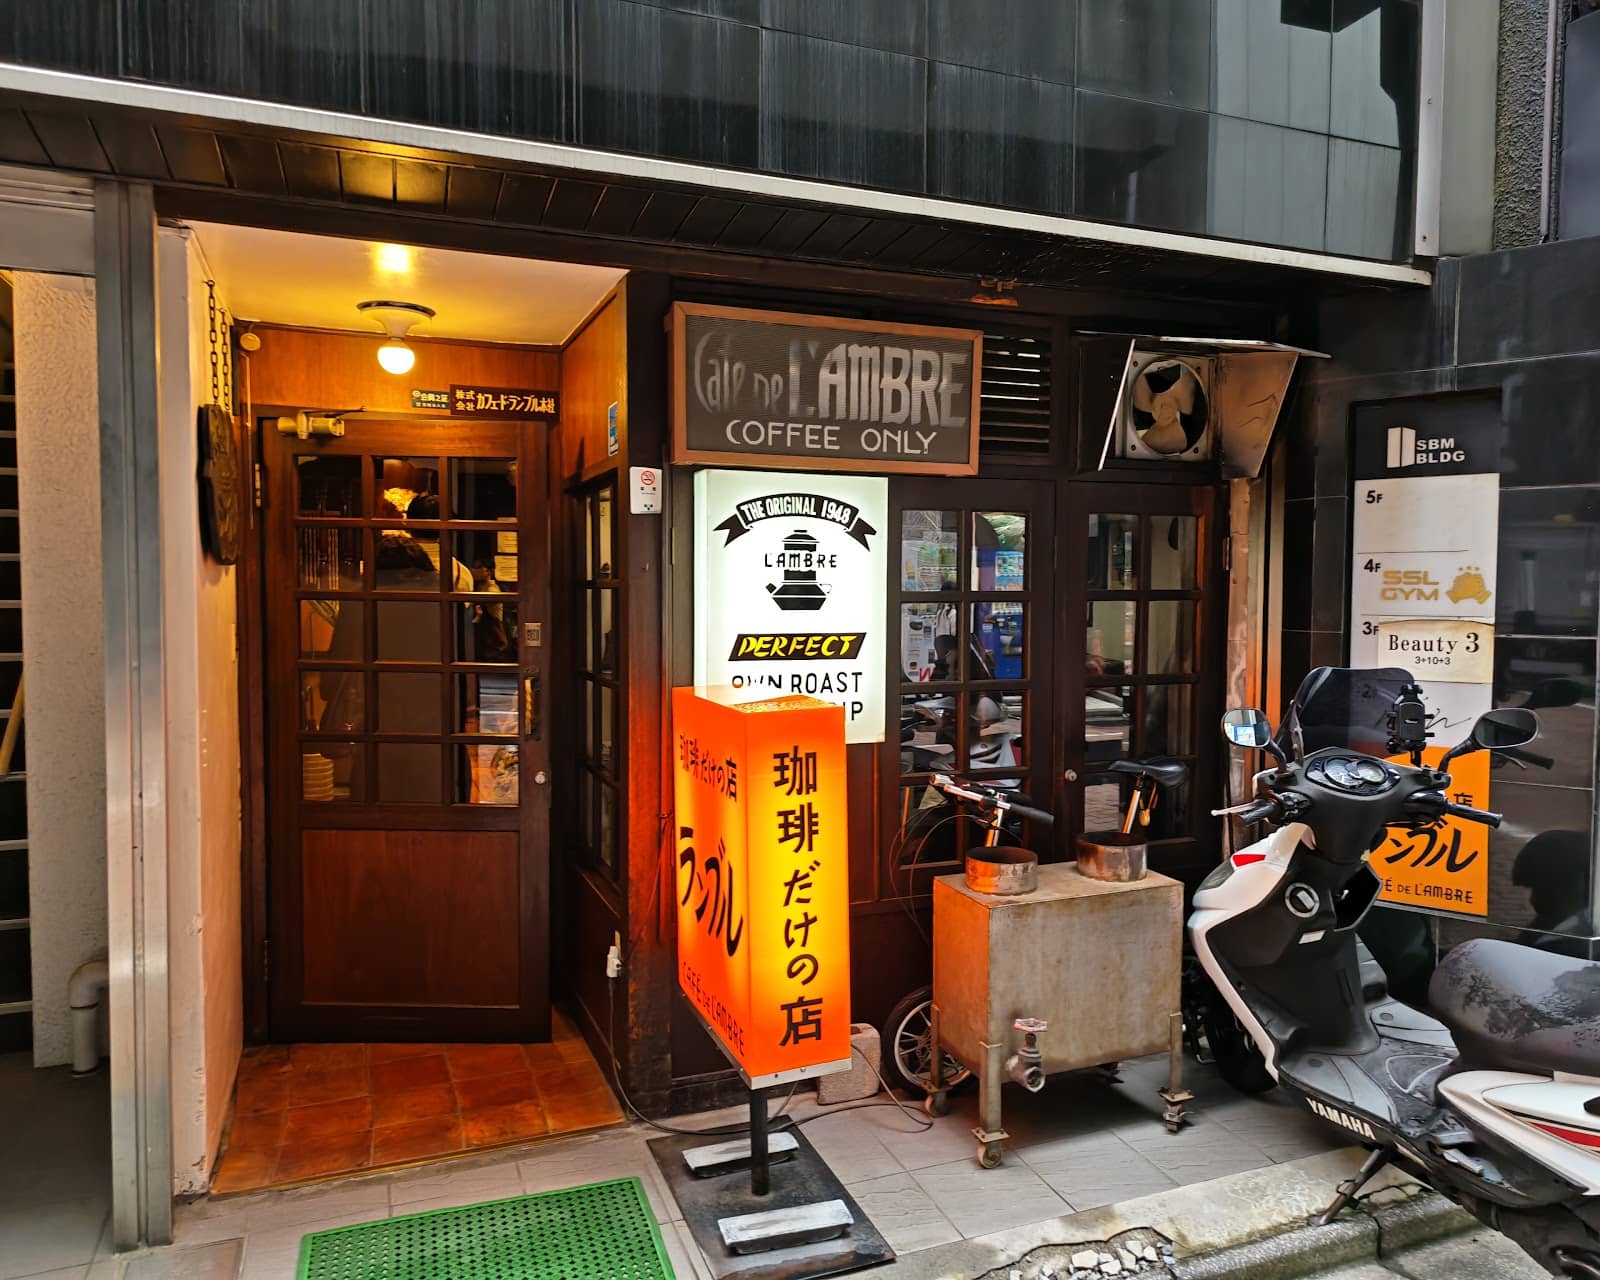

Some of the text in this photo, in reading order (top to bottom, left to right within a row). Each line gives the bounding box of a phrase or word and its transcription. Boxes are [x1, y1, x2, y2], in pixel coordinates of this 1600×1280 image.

[725, 419, 937, 454] COFFEE ONLY
[1416, 438, 1455, 451] SBM
[1416, 451, 1465, 465] BLDG
[1366, 490, 1384, 504] 5F
[741, 496, 851, 524] THE ORIGINAL 1948
[1363, 559, 1381, 573] 4F
[1382, 570, 1440, 586] SSL
[1379, 587, 1440, 601] GYM
[1362, 621, 1380, 636] 3F
[737, 635, 857, 658] PERFECT
[1388, 632, 1480, 655] Beauty 3
[1414, 655, 1451, 666] 3+10+3
[790, 671, 863, 694] ROAST
[680, 826, 744, 957] ランブル
[773, 745, 823, 1048] 珈琲だけの店
[1397, 883, 1411, 895] DE
[1306, 1097, 1377, 1141] YAMAHA
